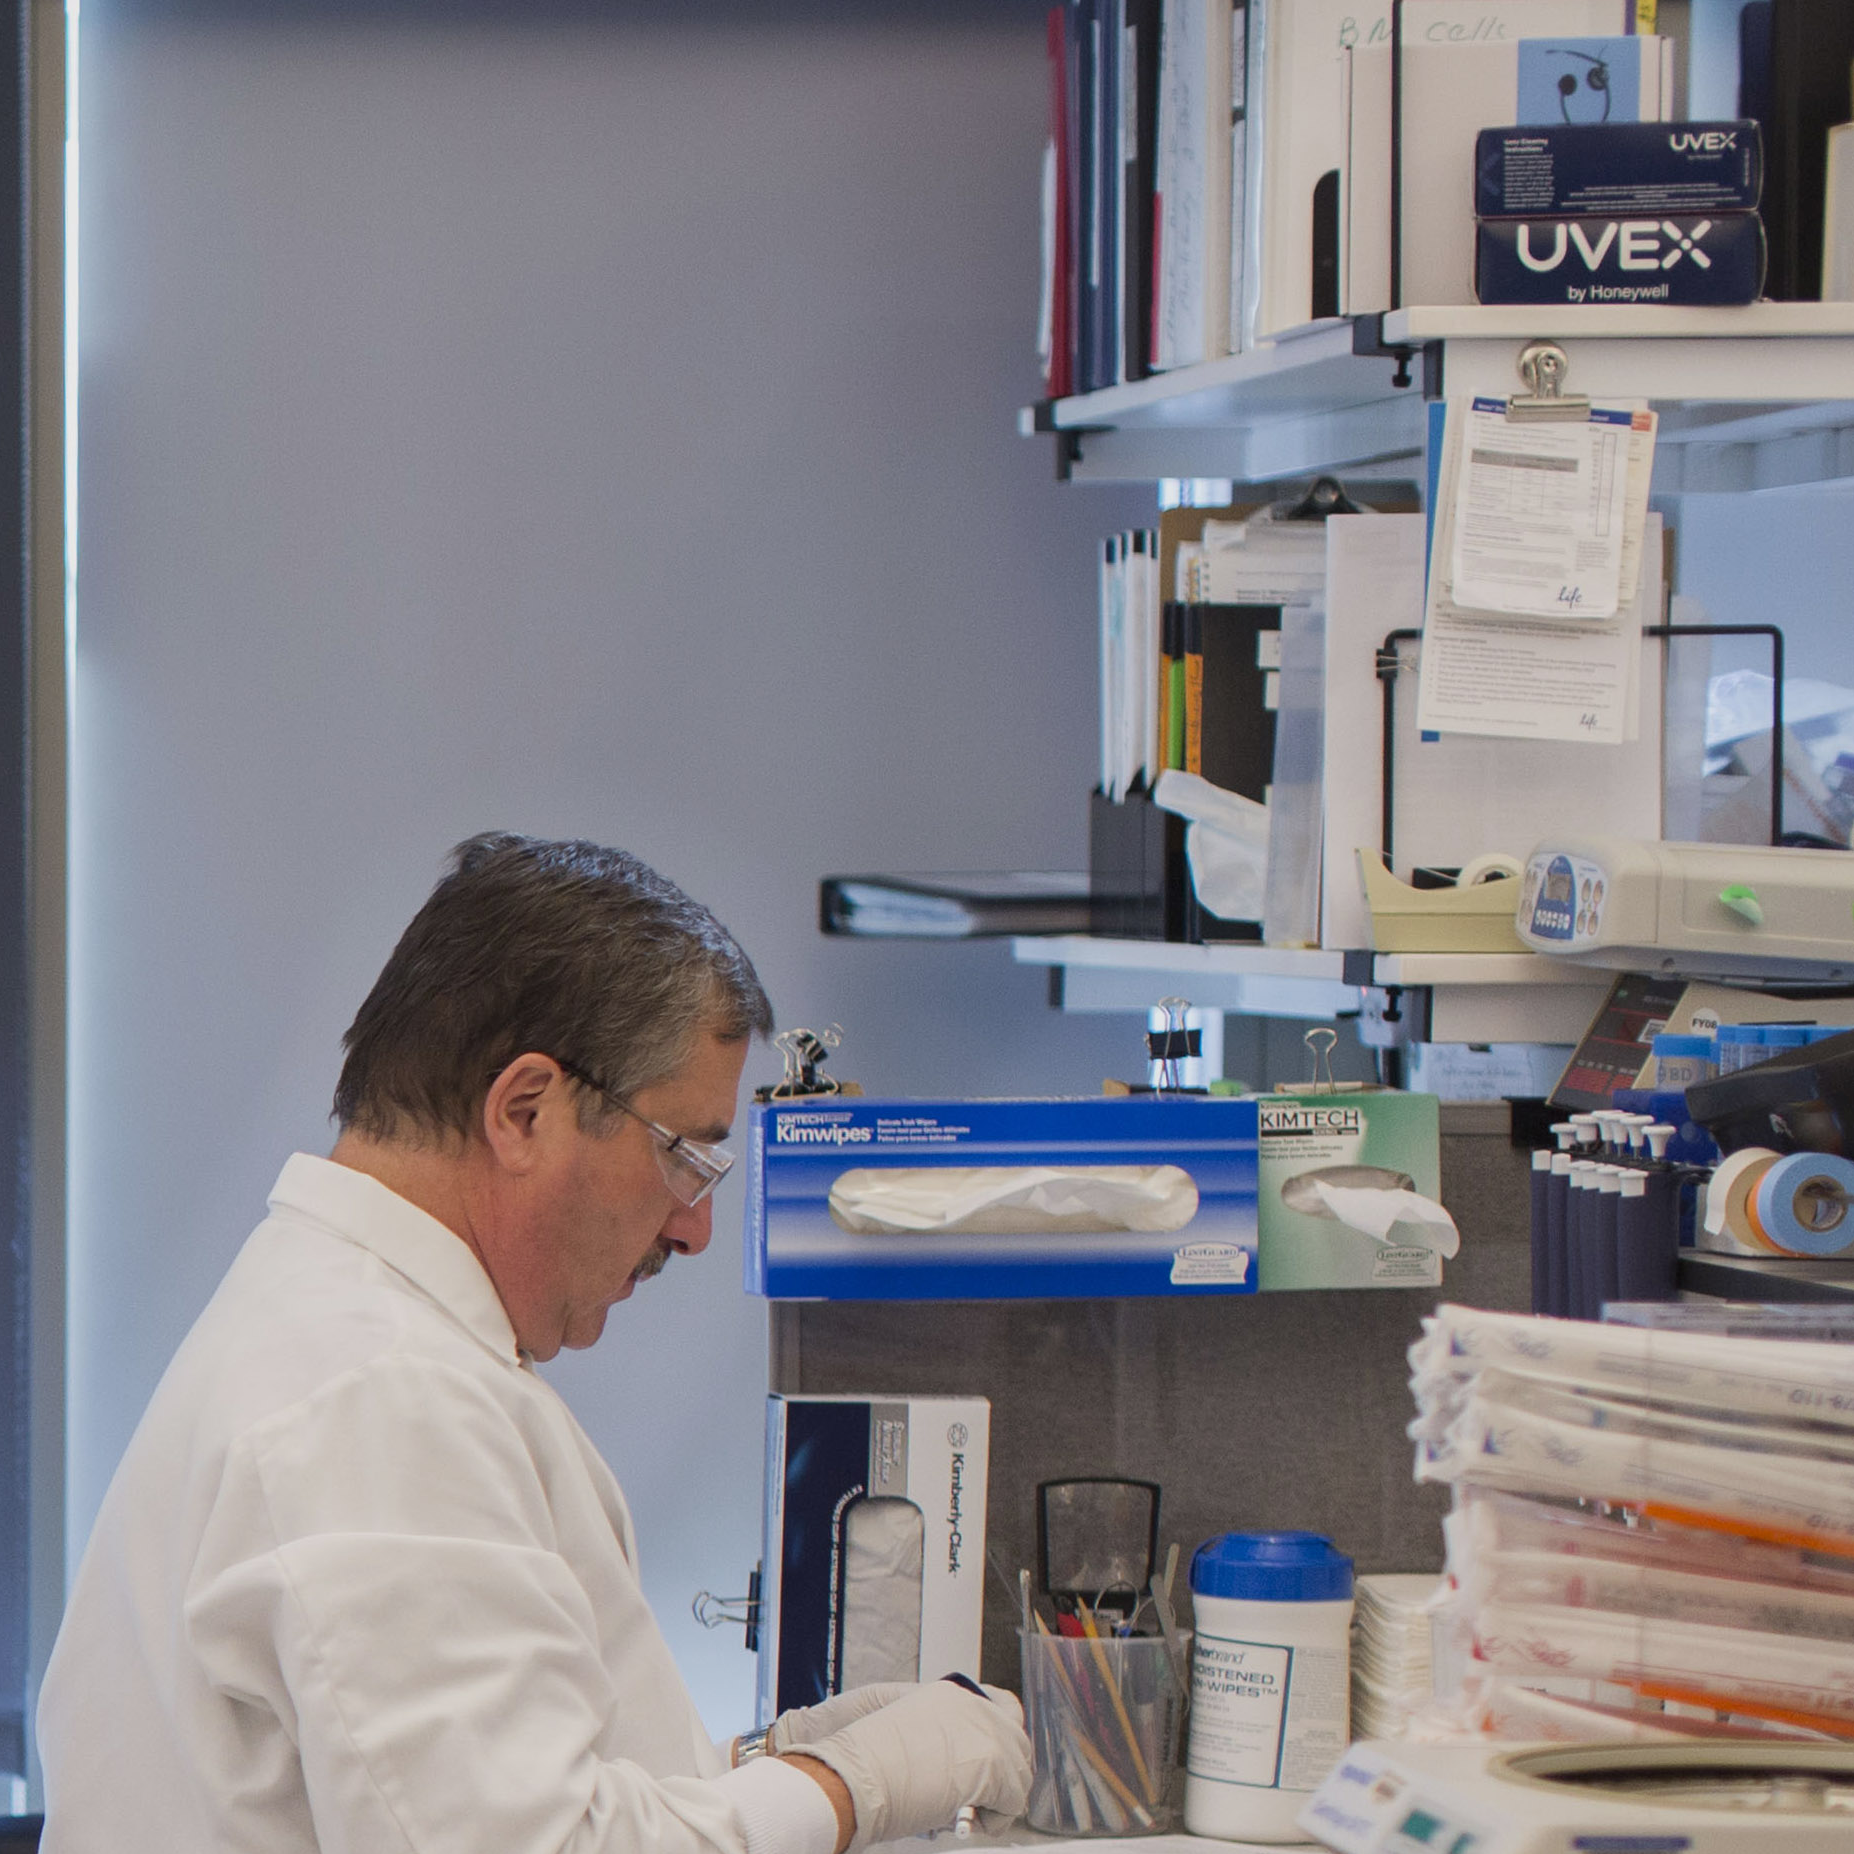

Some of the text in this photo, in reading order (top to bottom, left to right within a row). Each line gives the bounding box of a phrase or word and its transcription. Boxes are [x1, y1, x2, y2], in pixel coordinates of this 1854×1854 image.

[1670, 132, 1737, 150] UVEX
[1517, 220, 1712, 272] UVEX
[1568, 284, 1669, 301] by Honeywell
[1692, 1018, 1717, 1029] FY08
[1670, 1067, 1691, 1081] BD
[1261, 1110, 1359, 1128] KIMTECH
[947, 1453, 964, 1574] Kimberly-Clark
[1195, 1645, 1246, 1665] herbrand
[1194, 1664, 1275, 1685] OISTENED
[1193, 1680, 1279, 1698] N-WIPES™
